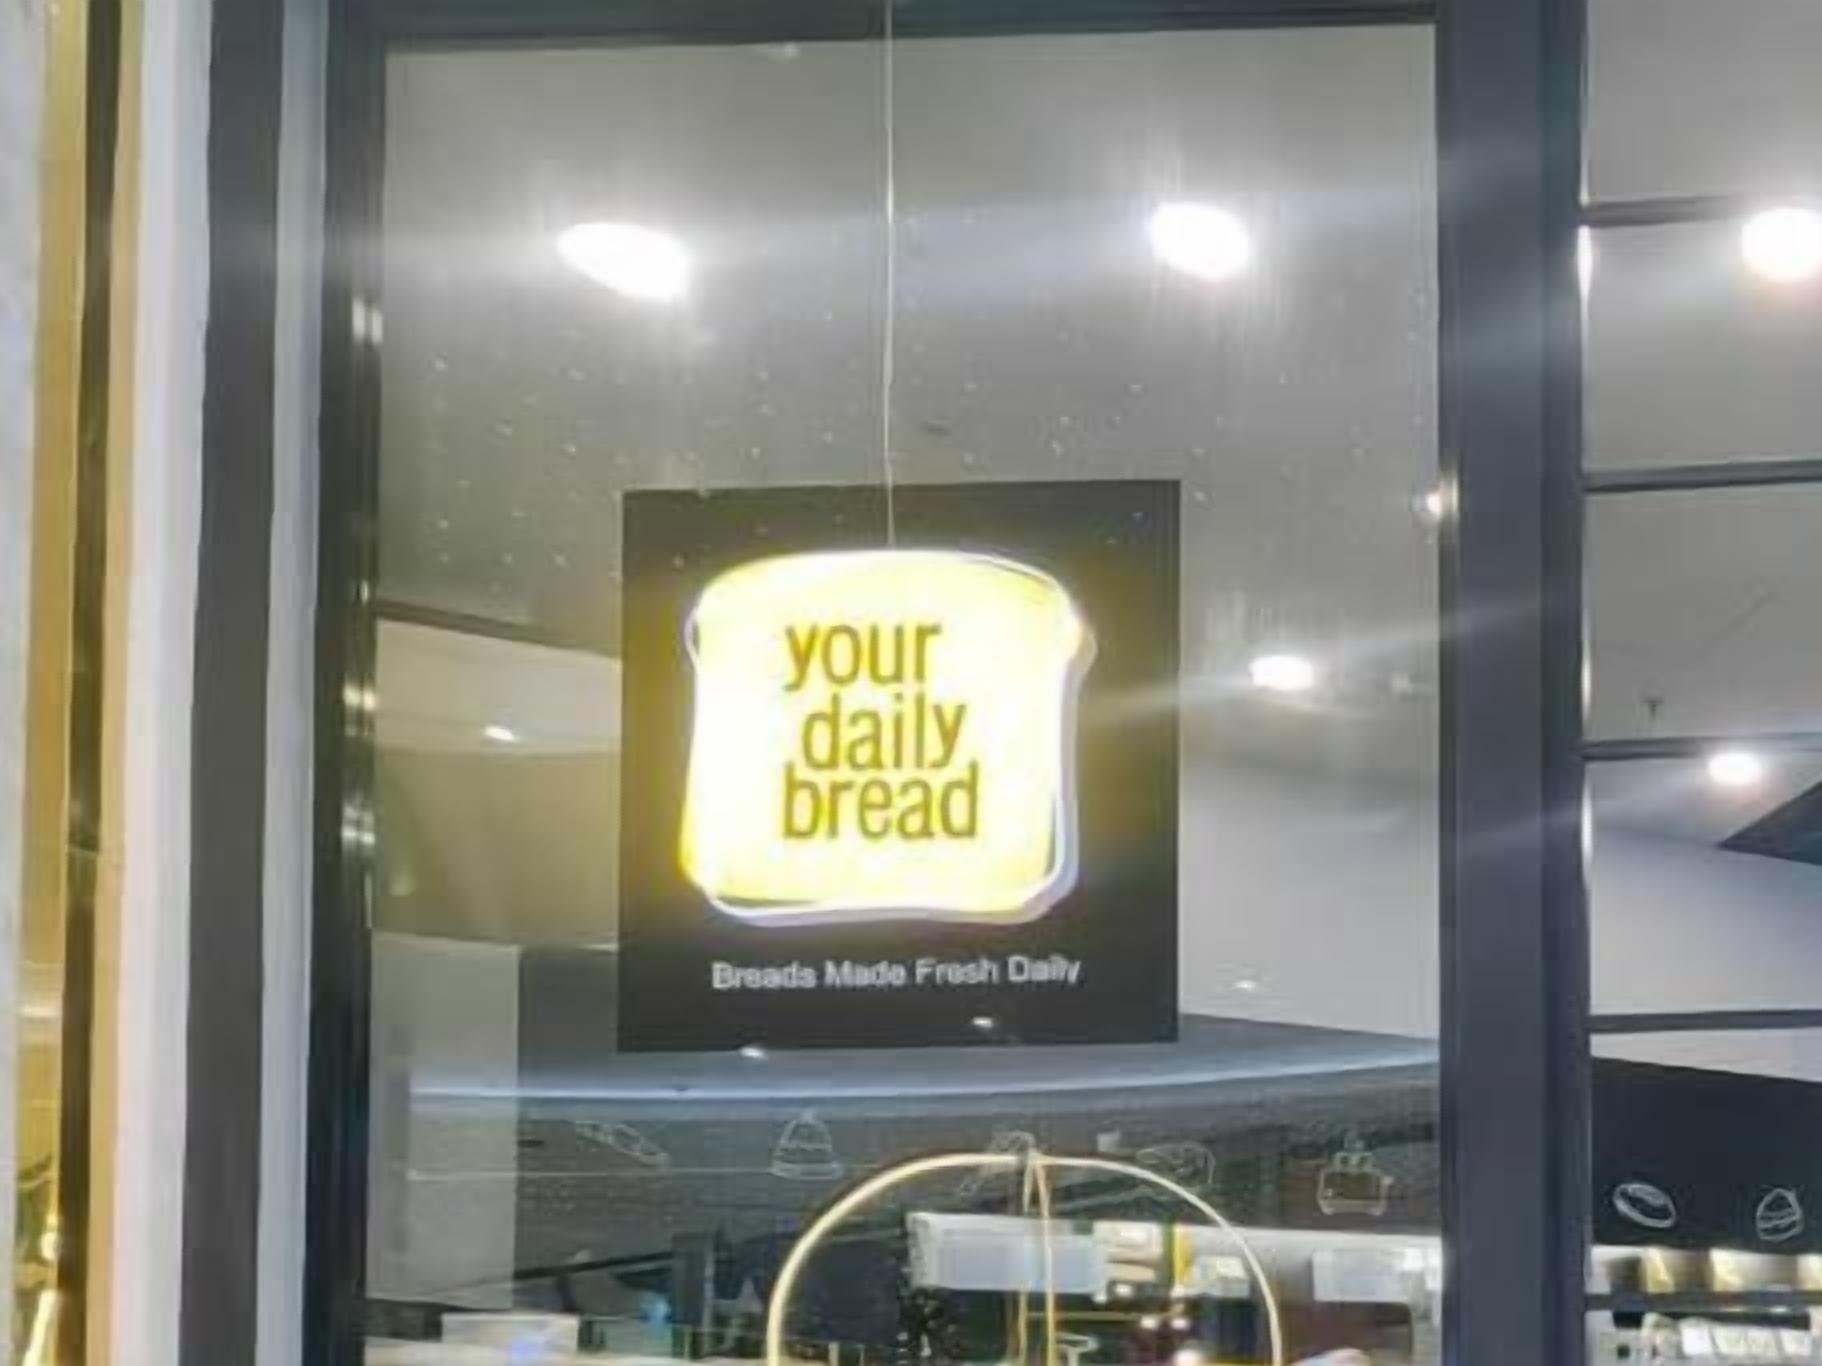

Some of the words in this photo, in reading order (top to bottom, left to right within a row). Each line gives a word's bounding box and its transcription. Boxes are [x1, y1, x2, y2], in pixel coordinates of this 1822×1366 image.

[783, 621, 943, 693] your
[801, 692, 967, 771] daily
[783, 758, 981, 841] bread
[711, 960, 817, 990] Breads
[824, 958, 907, 988] Made
[915, 956, 1000, 985] Fresh
[1007, 954, 1081, 985] Daily
